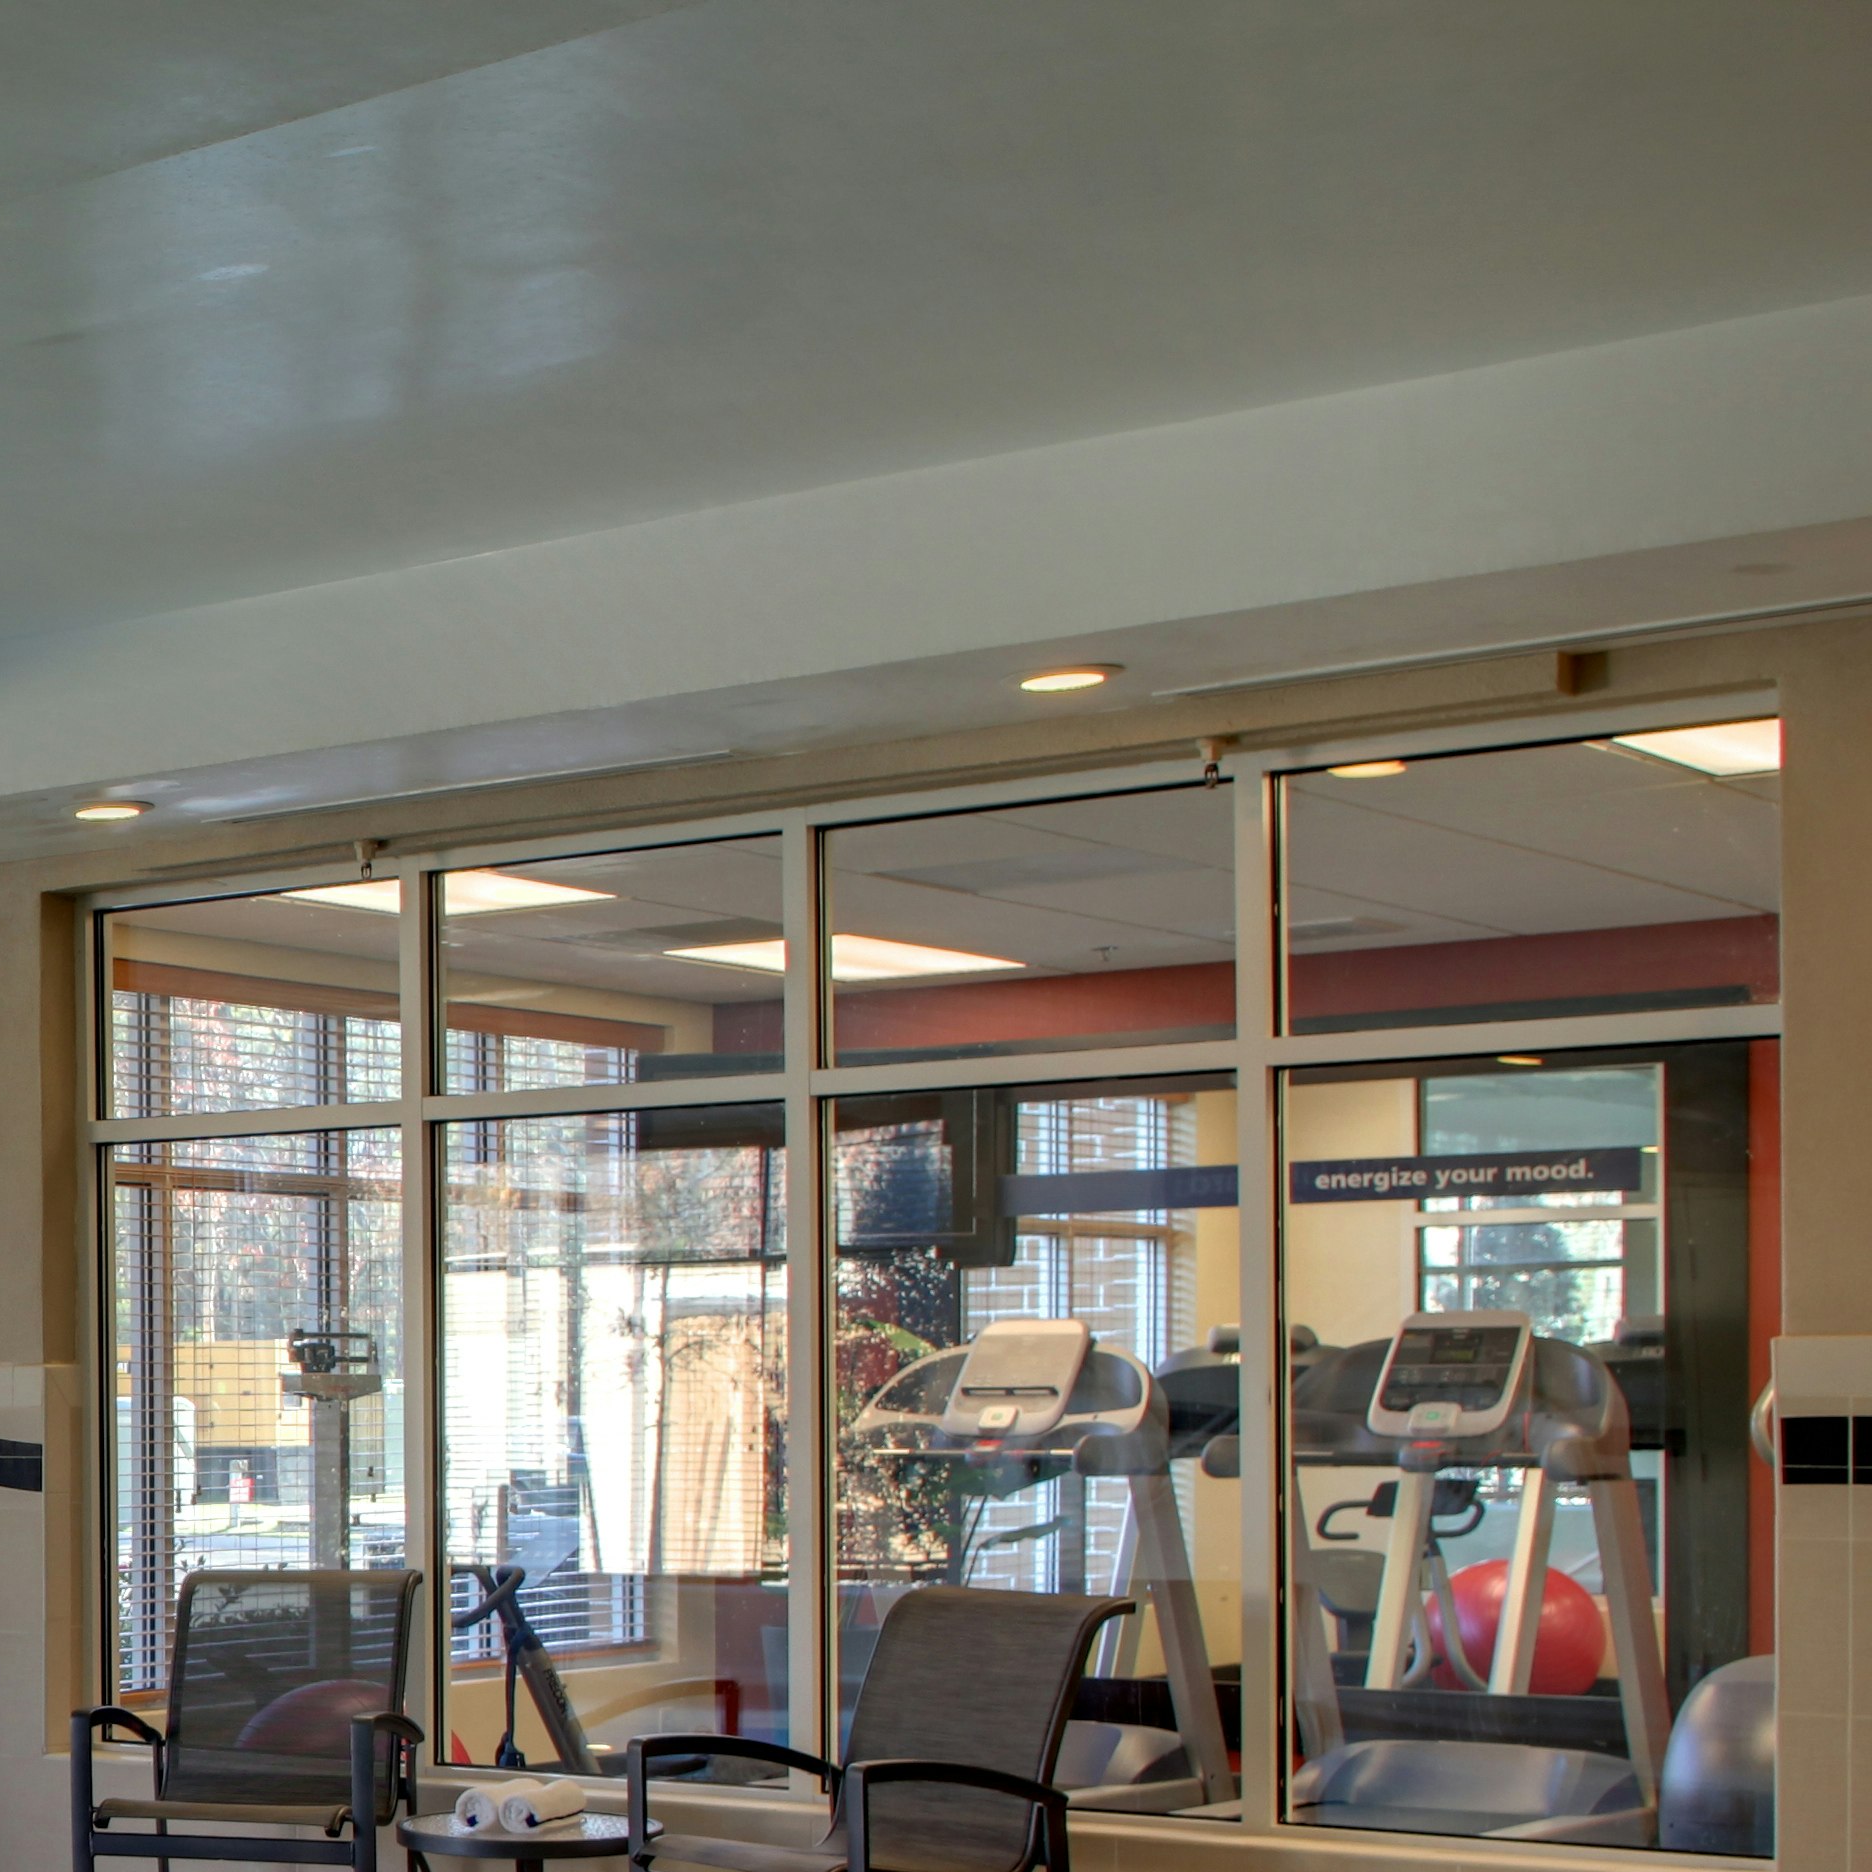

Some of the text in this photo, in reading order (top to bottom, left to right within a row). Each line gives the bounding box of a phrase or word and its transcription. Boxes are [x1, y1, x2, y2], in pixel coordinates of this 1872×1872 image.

[1314, 1158, 1594, 1192] energize your mood.
